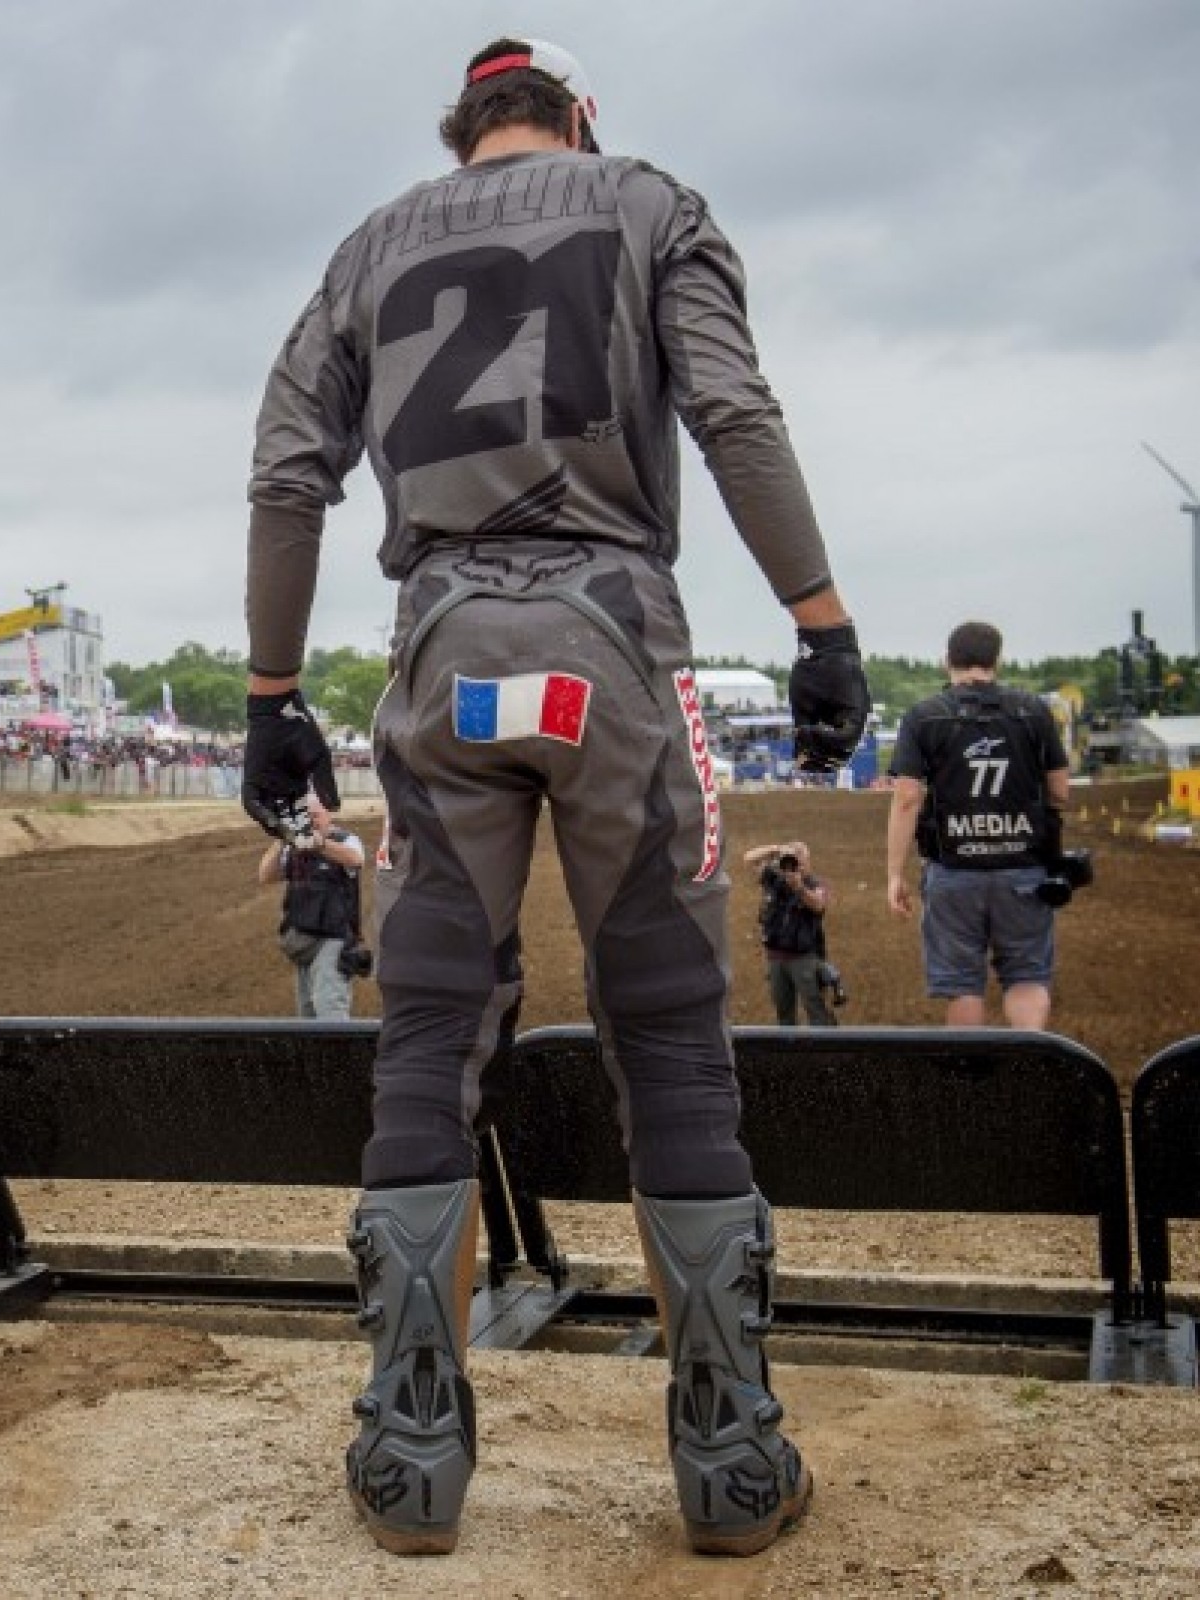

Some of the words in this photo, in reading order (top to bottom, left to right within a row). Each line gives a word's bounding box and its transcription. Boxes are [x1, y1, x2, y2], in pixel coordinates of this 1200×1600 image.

[372, 162, 620, 265] PAULIN
[377, 230, 621, 476] 21
[968, 760, 1010, 798] 77
[947, 814, 1033, 837] MEDIA
